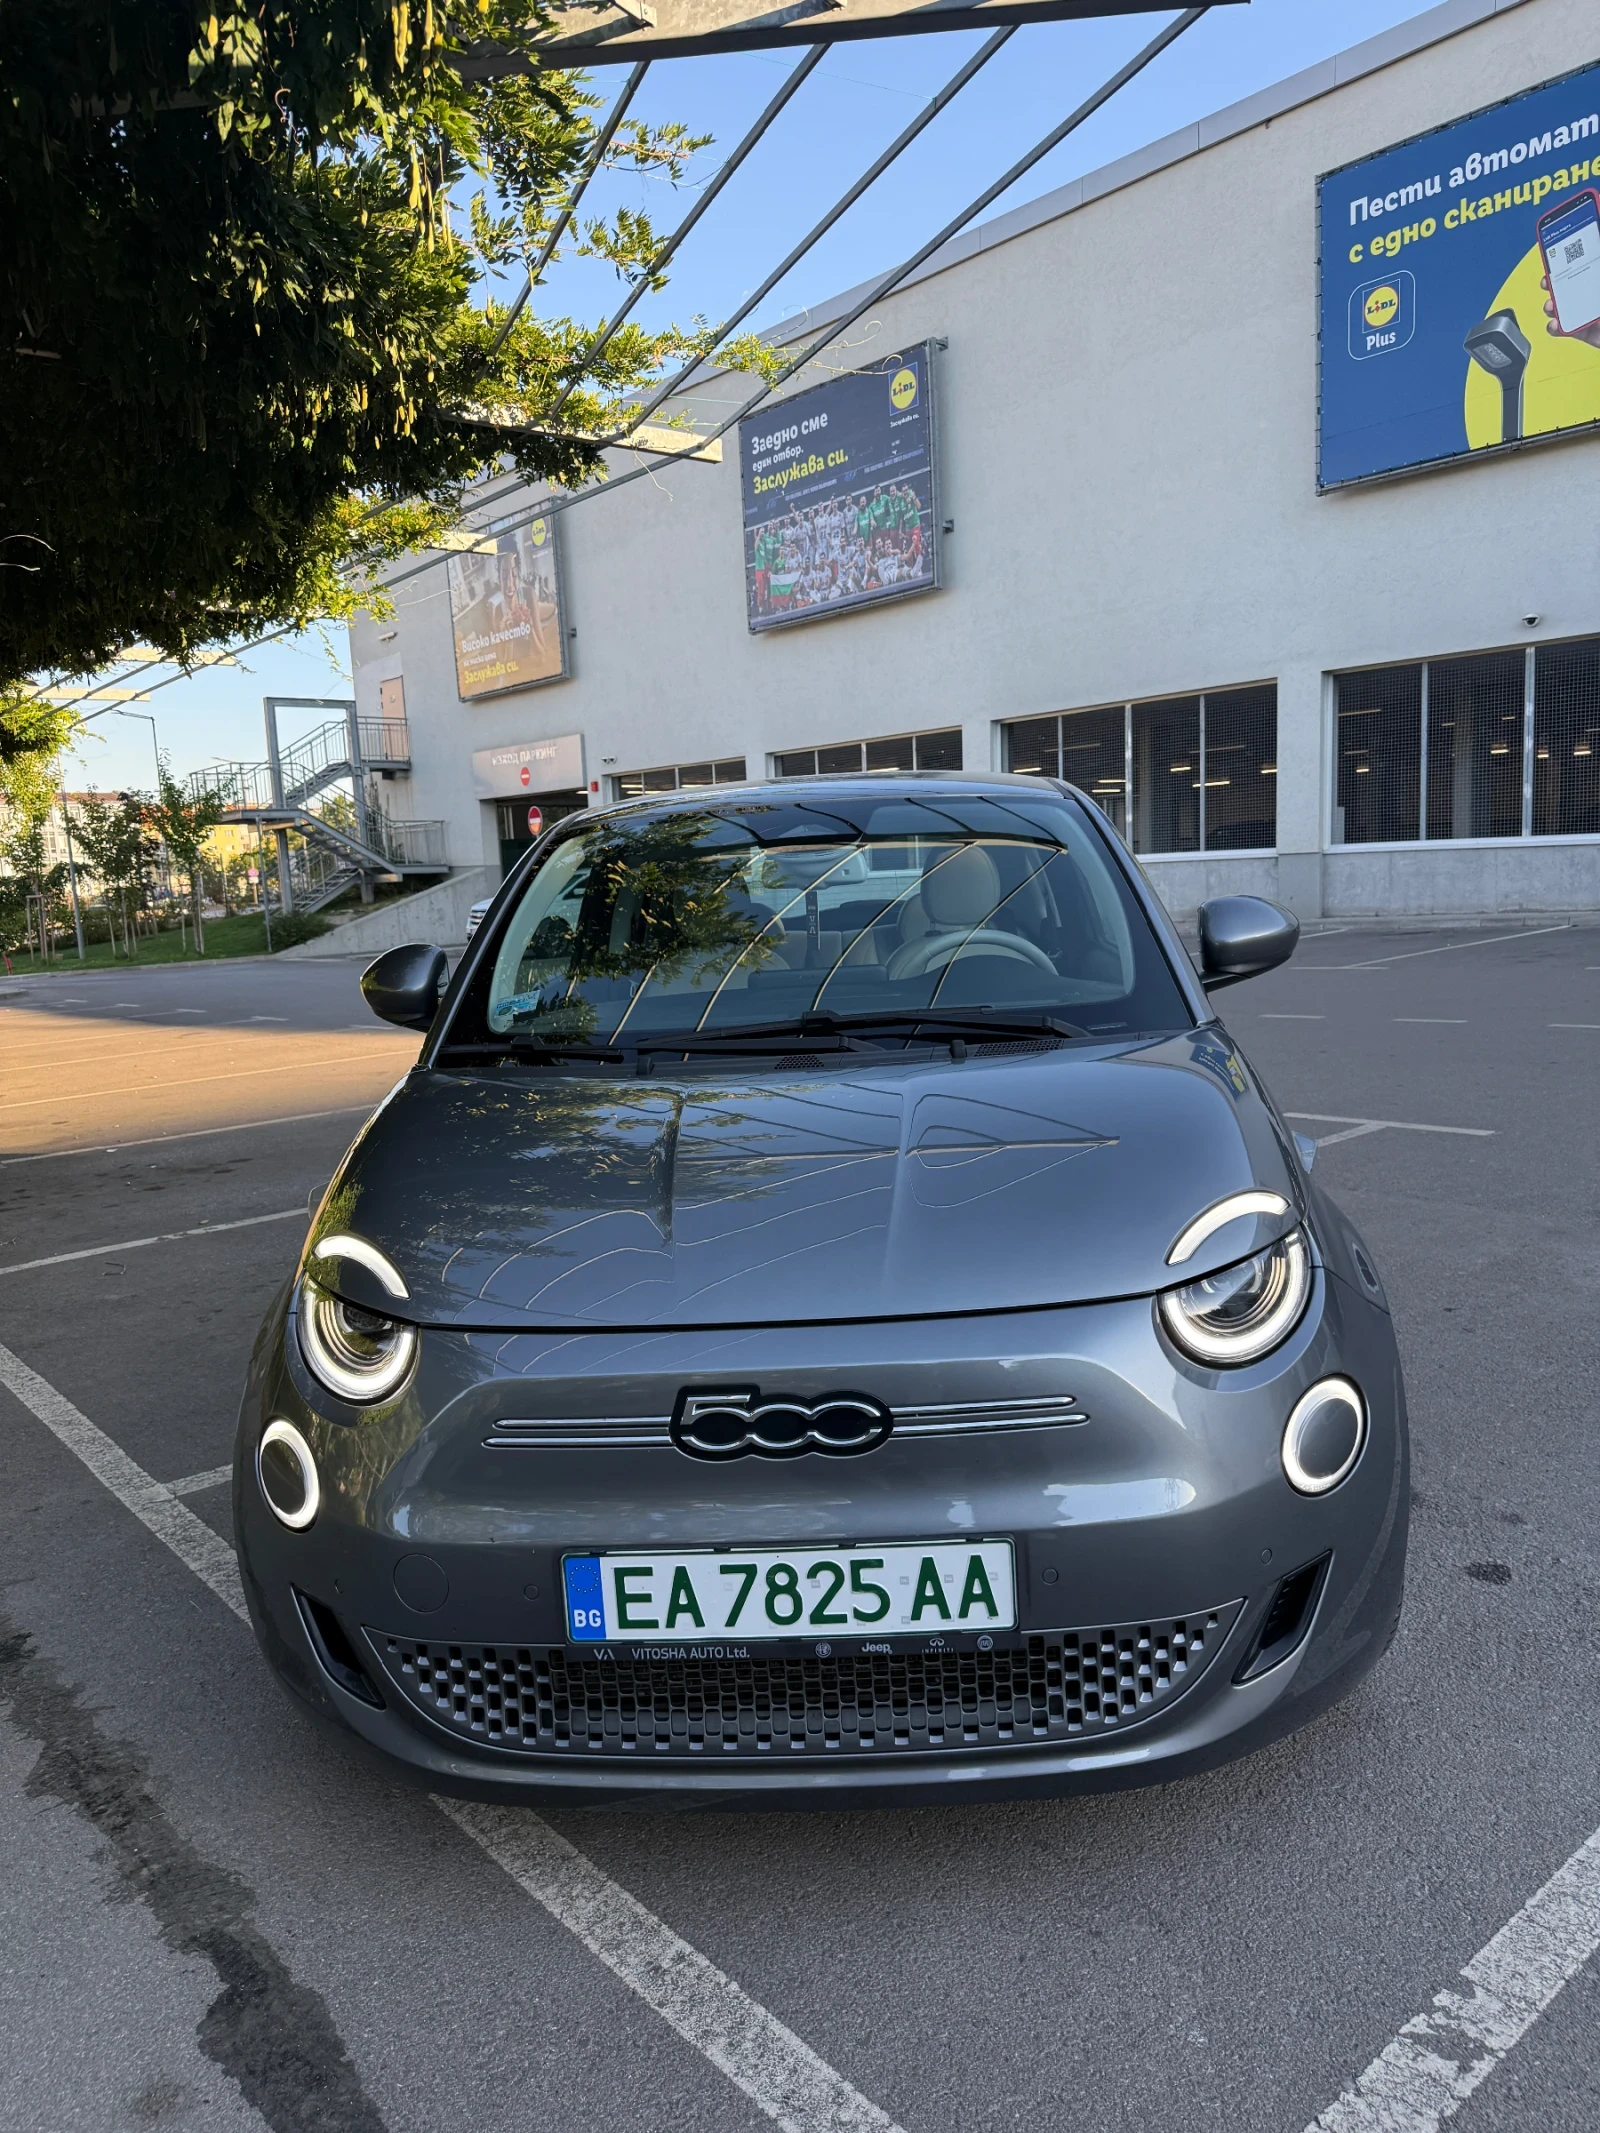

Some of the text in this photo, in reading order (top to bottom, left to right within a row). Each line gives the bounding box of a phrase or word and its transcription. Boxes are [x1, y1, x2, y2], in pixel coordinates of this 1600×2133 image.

[1350, 113, 1599, 226] Пести автомат
[1349, 243, 1363, 263] с
[1370, 217, 1436, 257] едно
[1366, 331, 1396, 351] Plus
[751, 413, 828, 455] Заедно сме
[752, 445, 804, 473] един отбор.
[753, 454, 825, 494] Заслужава
[827, 449, 849, 467] си.
[462, 621, 531, 653] Високо качество
[464, 661, 506, 684] Заслужава
[680, 1394, 883, 1452] 500
[573, 1609, 601, 1628] BG
[631, 1647, 687, 1660] VITOSHA
[690, 1646, 724, 1659] AUTO
[726, 1645, 750, 1659] Ltd.
[861, 1642, 891, 1653] Jeep
